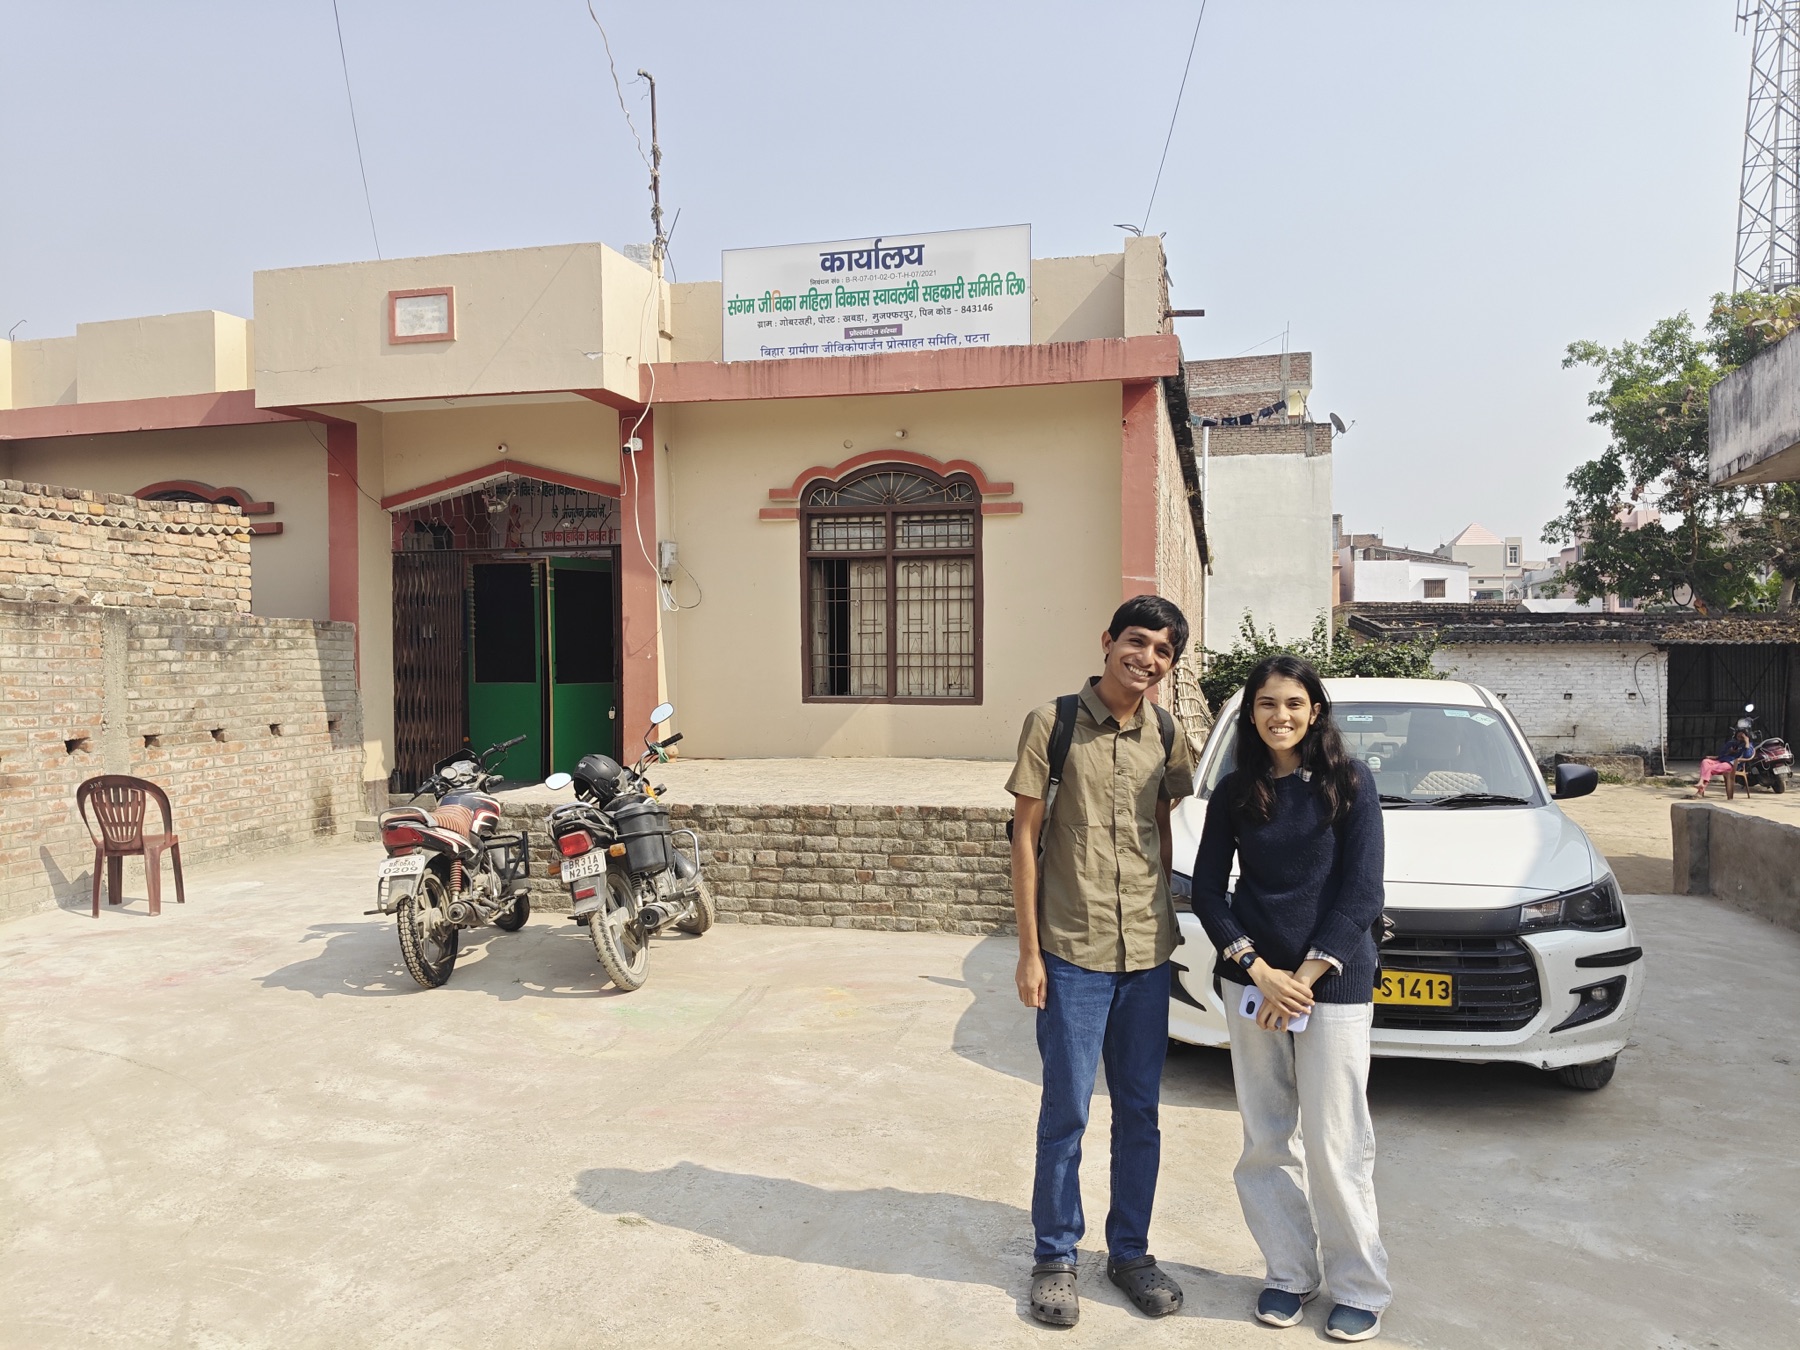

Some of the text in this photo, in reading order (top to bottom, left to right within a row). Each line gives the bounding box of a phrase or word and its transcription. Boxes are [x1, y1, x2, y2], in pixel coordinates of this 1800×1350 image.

[819, 238, 925, 273] कार्यालय
[727, 293, 755, 316] संगम
[757, 289, 796, 314] जीविका
[799, 286, 833, 312] महिला
[835, 285, 871, 309] विकास
[872, 279, 919, 306] स्वावलंबी
[922, 275, 965, 303] सहकारी
[967, 272, 1004, 299] समिति
[918, 306, 934, 317] पिन
[935, 304, 952, 316] कोड
[960, 302, 994, 314] 843146
[788, 342, 819, 356] ग्रामीण
[821, 337, 883, 354] जीविकोपार्जन
[886, 336, 925, 350] प्रोत्साहन
[964, 332, 991, 344] पटना
[383, 866, 419, 875] 0209
[568, 854, 599, 870] BR31A
[569, 863, 600, 879] N2152
[1381, 977, 1450, 1000] S1413
